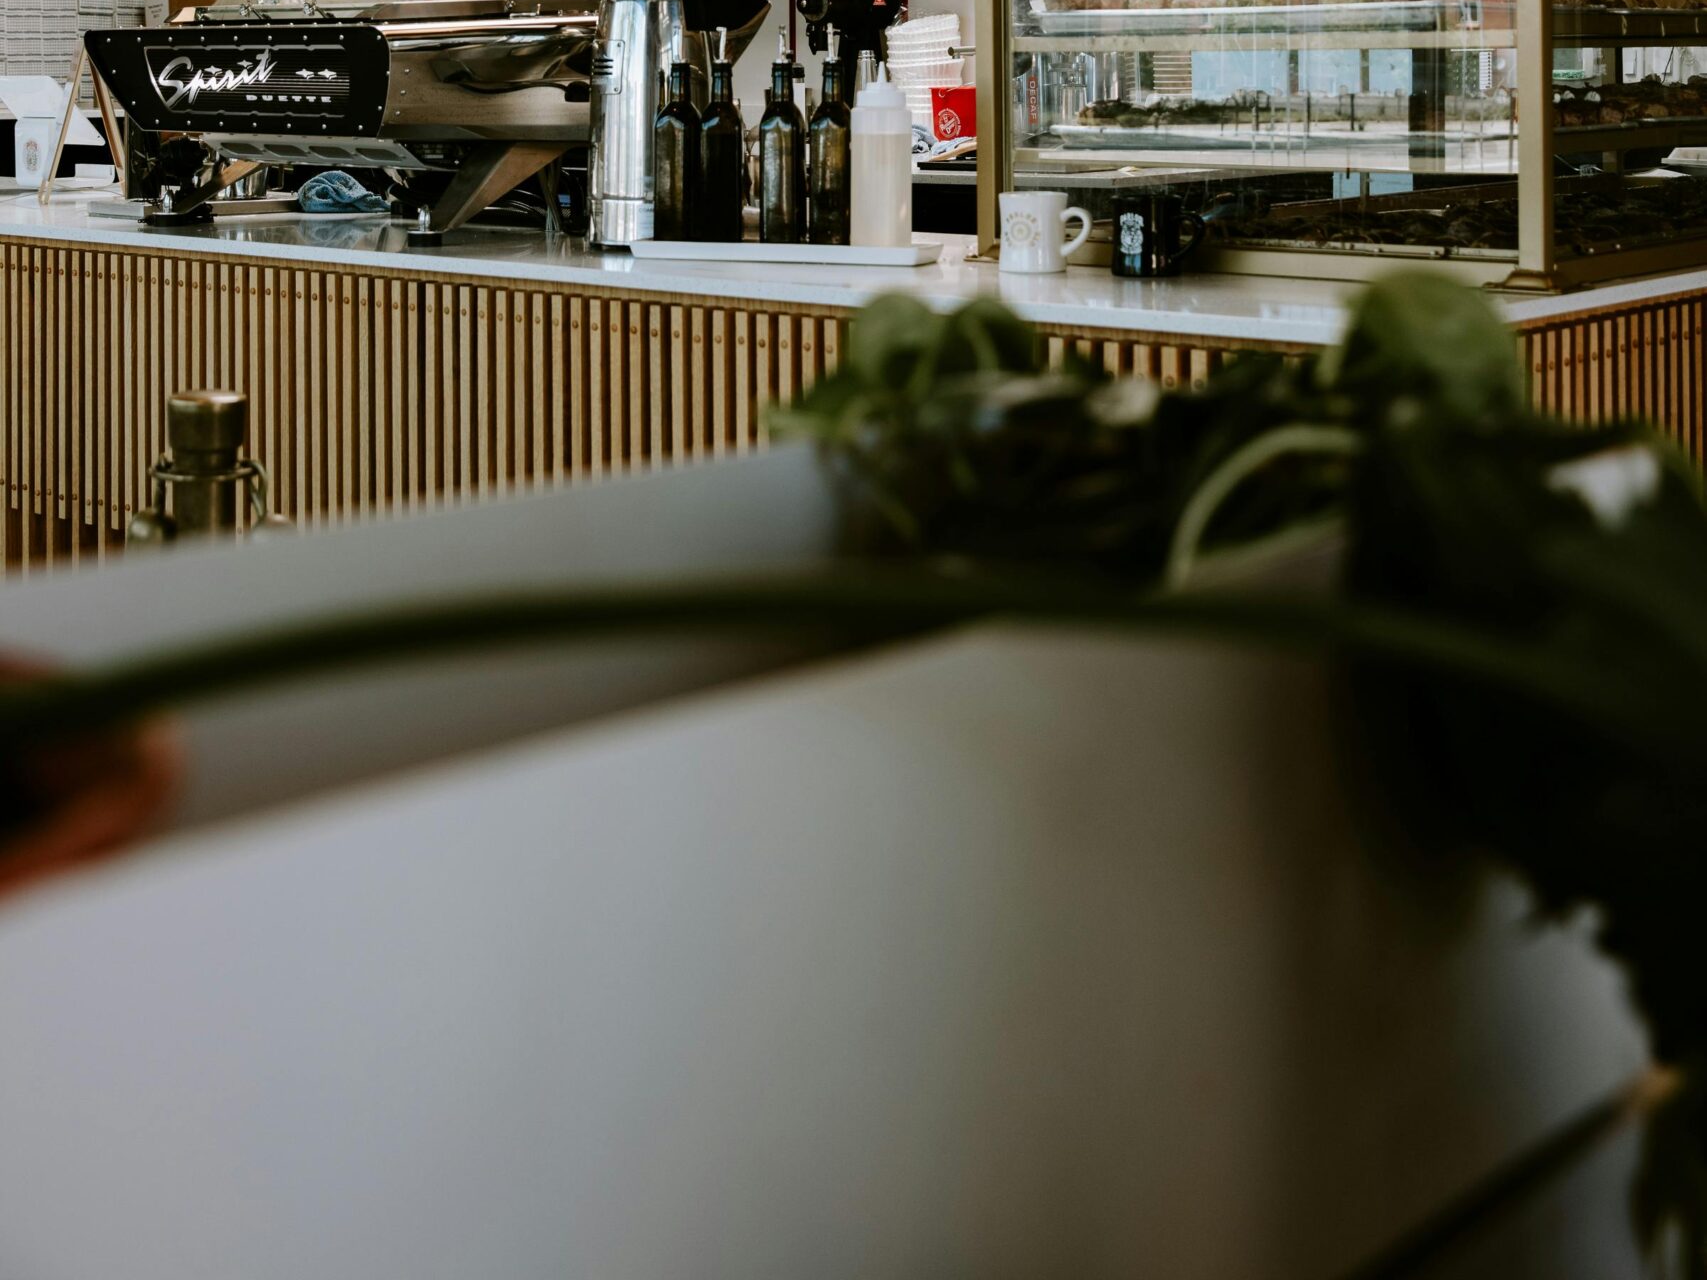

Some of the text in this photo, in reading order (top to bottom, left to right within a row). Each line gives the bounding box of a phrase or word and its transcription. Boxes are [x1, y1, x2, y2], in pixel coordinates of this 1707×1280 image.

[158, 48, 278, 108] Spirit
[246, 94, 332, 103] DUETTE
[1029, 80, 1037, 120] DECAF
